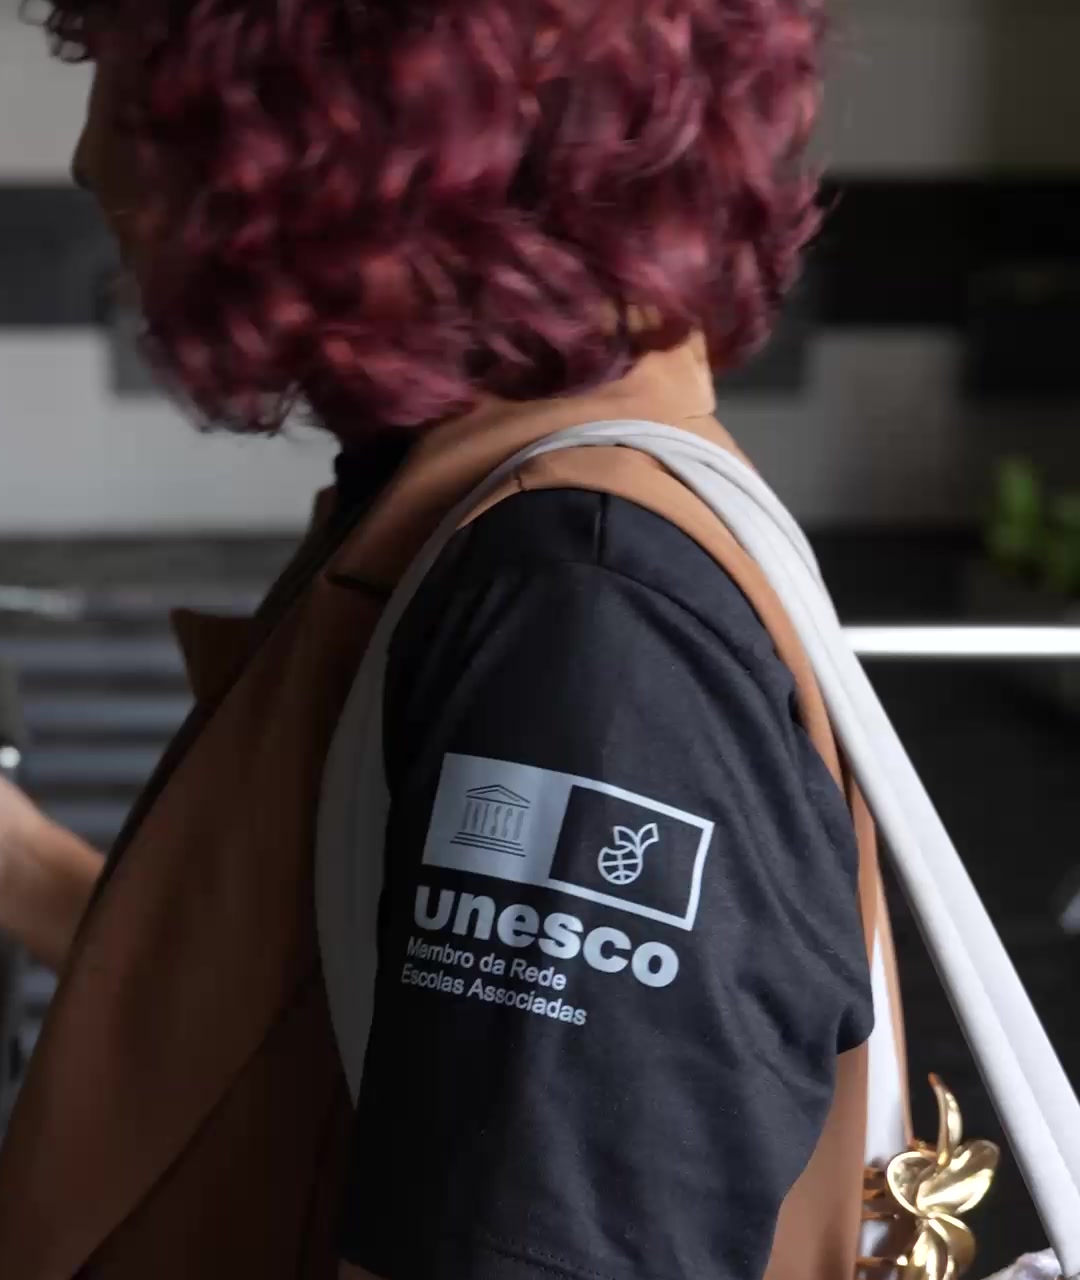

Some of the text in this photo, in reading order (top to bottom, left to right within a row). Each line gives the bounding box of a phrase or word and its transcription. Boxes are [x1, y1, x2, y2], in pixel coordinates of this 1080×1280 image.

[406, 935, 568, 991] Membro da Rede
[413, 884, 681, 989] unesco
[400, 963, 588, 1026] Escolas Associadas
